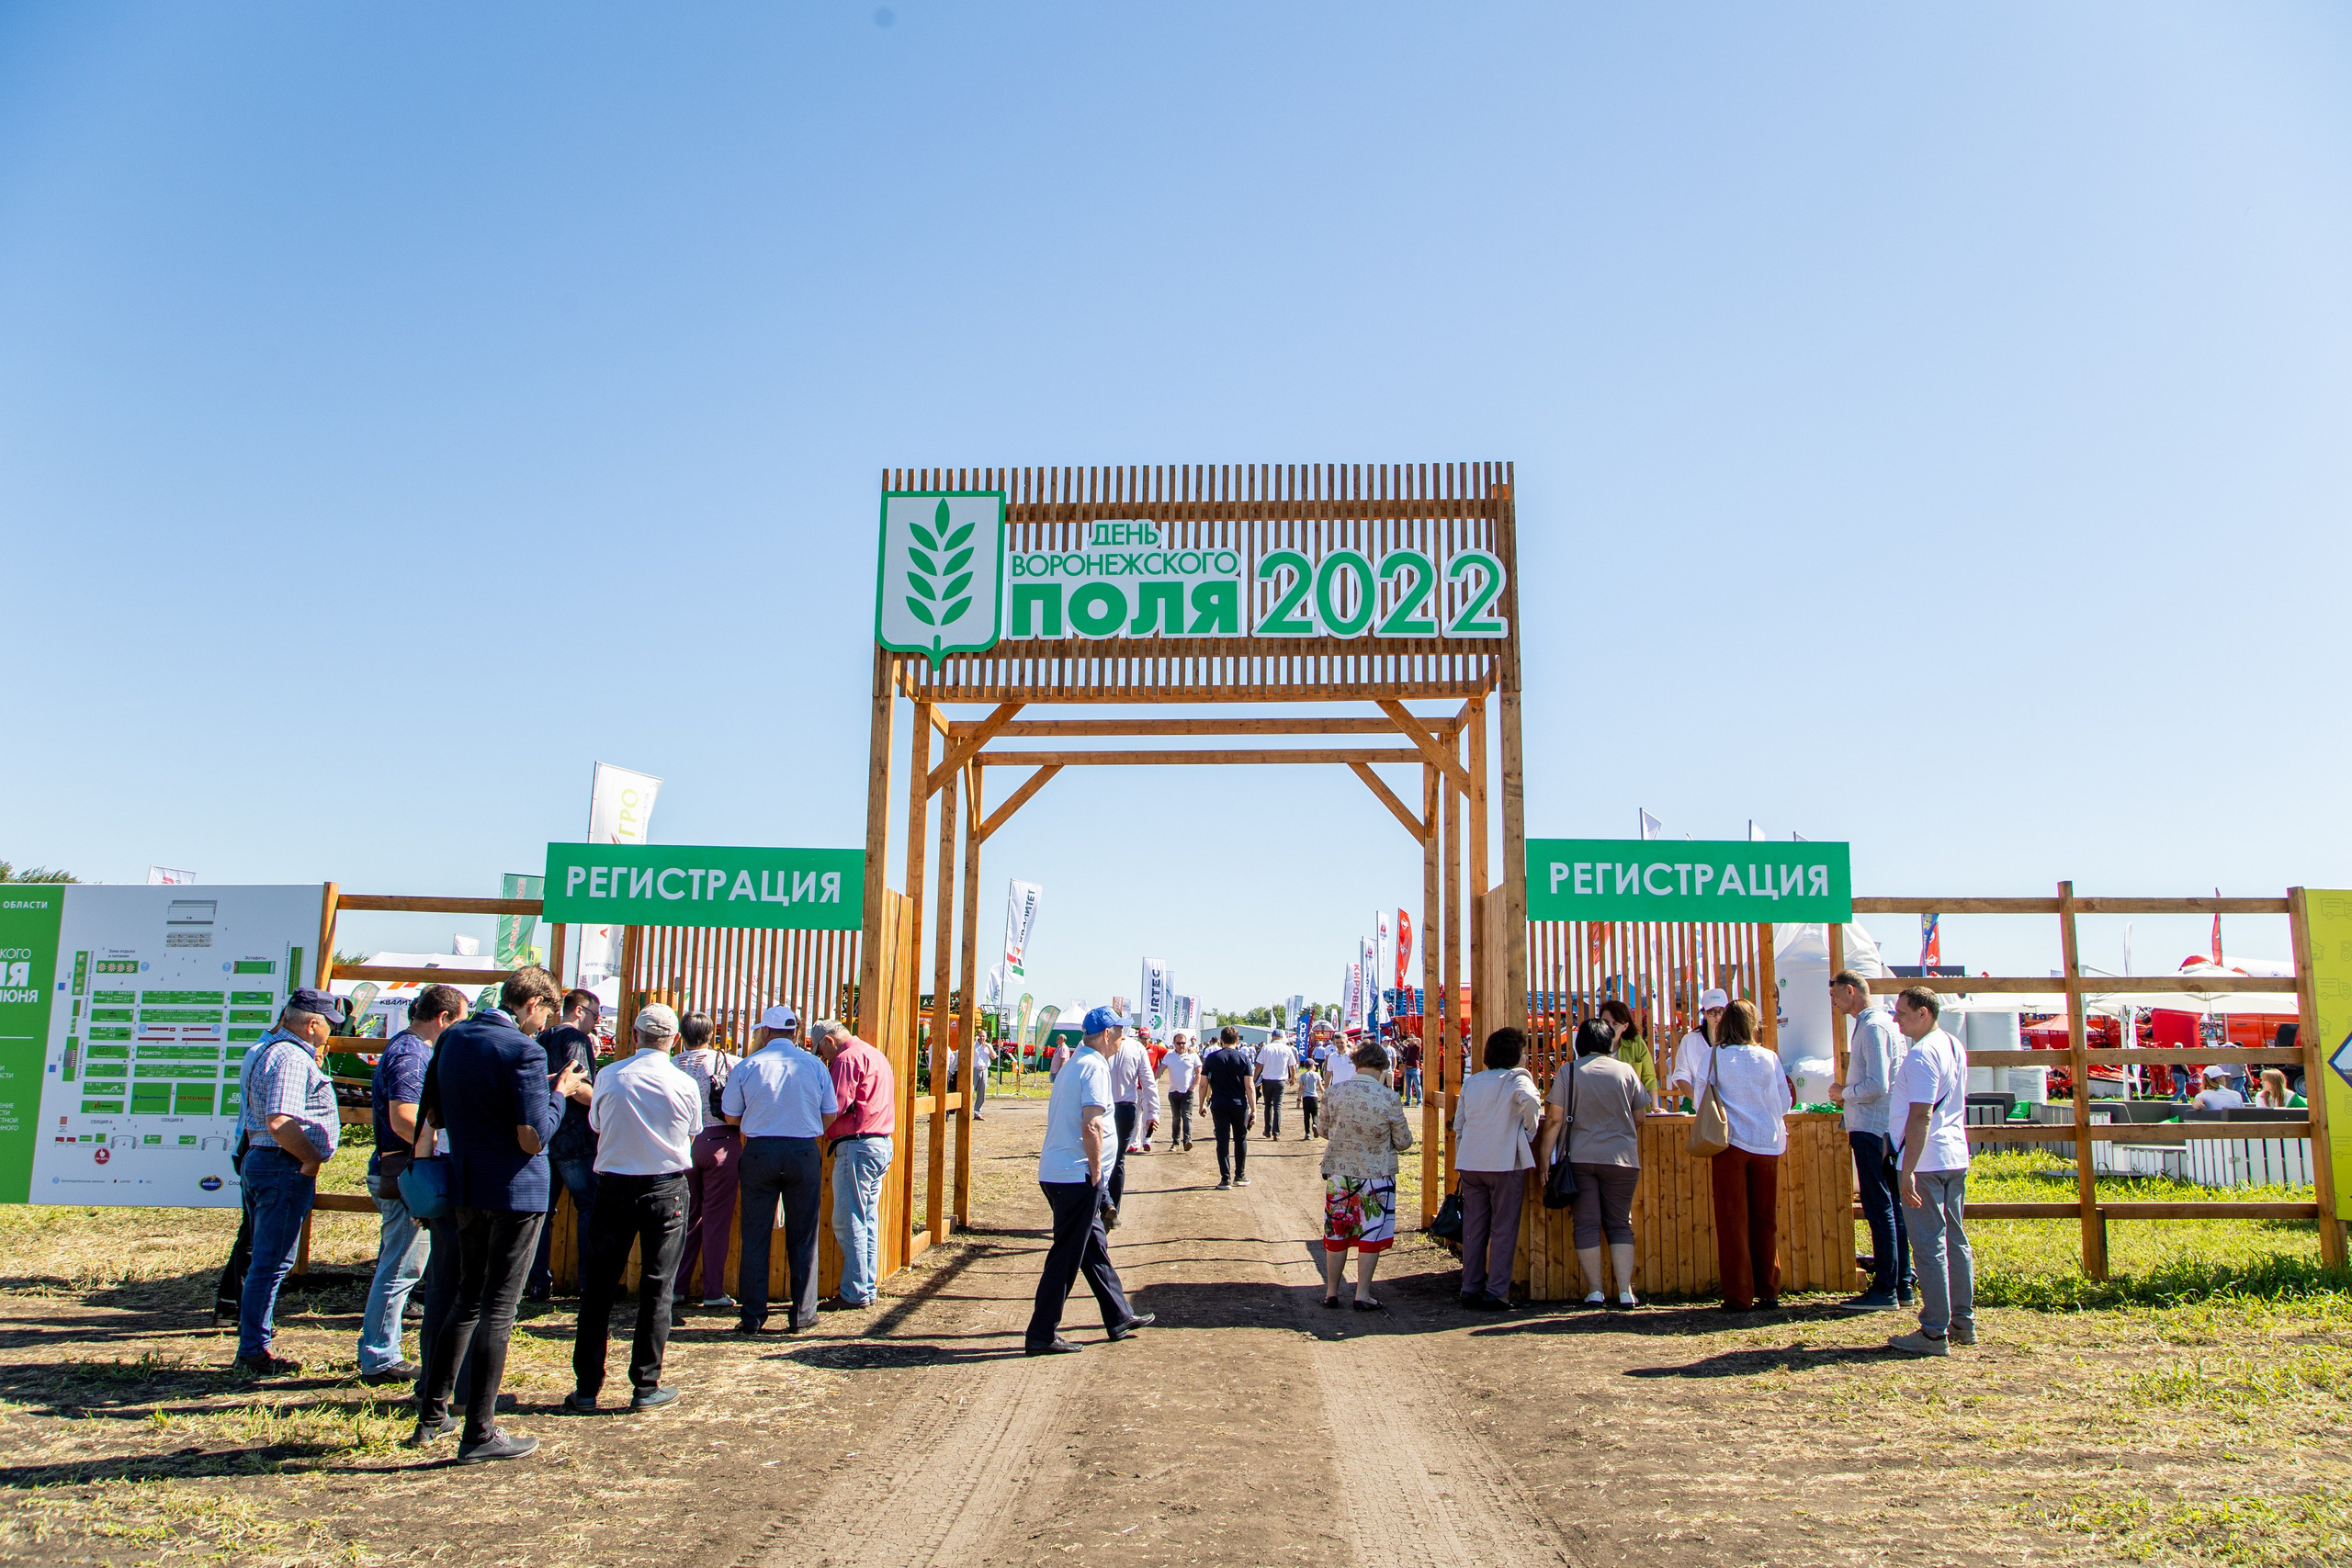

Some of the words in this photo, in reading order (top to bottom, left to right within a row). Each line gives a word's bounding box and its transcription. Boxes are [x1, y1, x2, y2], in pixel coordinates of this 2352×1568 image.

[1091, 523, 1159, 547] ДЕНЬ
[1012, 551, 1238, 578] ВОРОНЕЖСКОГО
[1012, 580, 1238, 636] ПОЛЯ
[1257, 550, 1502, 633] 2022
[566, 865, 841, 907] РЕГИСТРАЦИЯ
[1549, 862, 1829, 901] РЕГИСТРАЦИЯ
[3, 900, 48, 909] ОБЛАСТИ
[508, 877, 526, 953] AMAZNE
[1350, 964, 1361, 1017] КИРОВЕЦ
